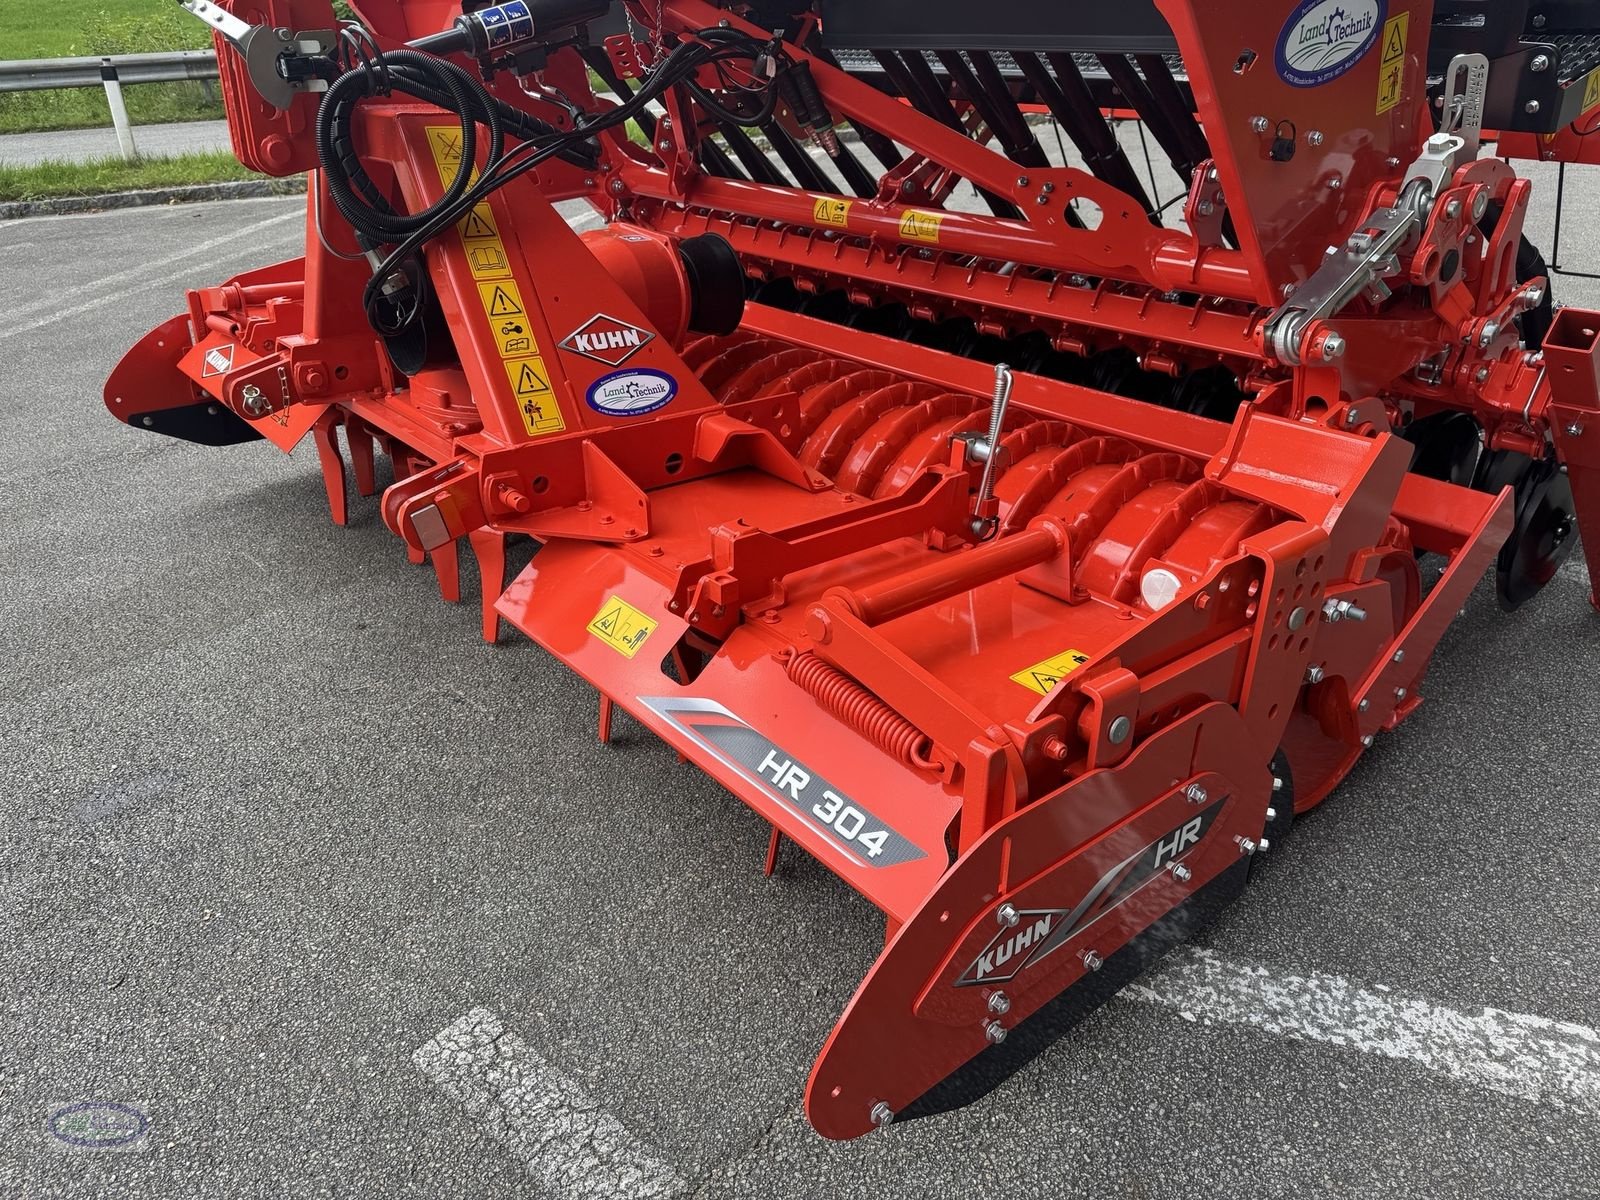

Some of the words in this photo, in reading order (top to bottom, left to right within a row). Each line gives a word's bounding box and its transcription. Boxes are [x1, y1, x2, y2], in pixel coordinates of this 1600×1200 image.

[1298, 16, 1327, 45] Land
[1334, 12, 1372, 43] Technik
[575, 329, 641, 352] KUHN
[206, 350, 231, 373] KUHN
[603, 385, 626, 398] Land
[634, 383, 666, 398] Technik
[757, 749, 811, 801] HR
[812, 790, 890, 858] 304
[1154, 816, 1203, 869] HR
[976, 914, 1052, 980] KUHN
